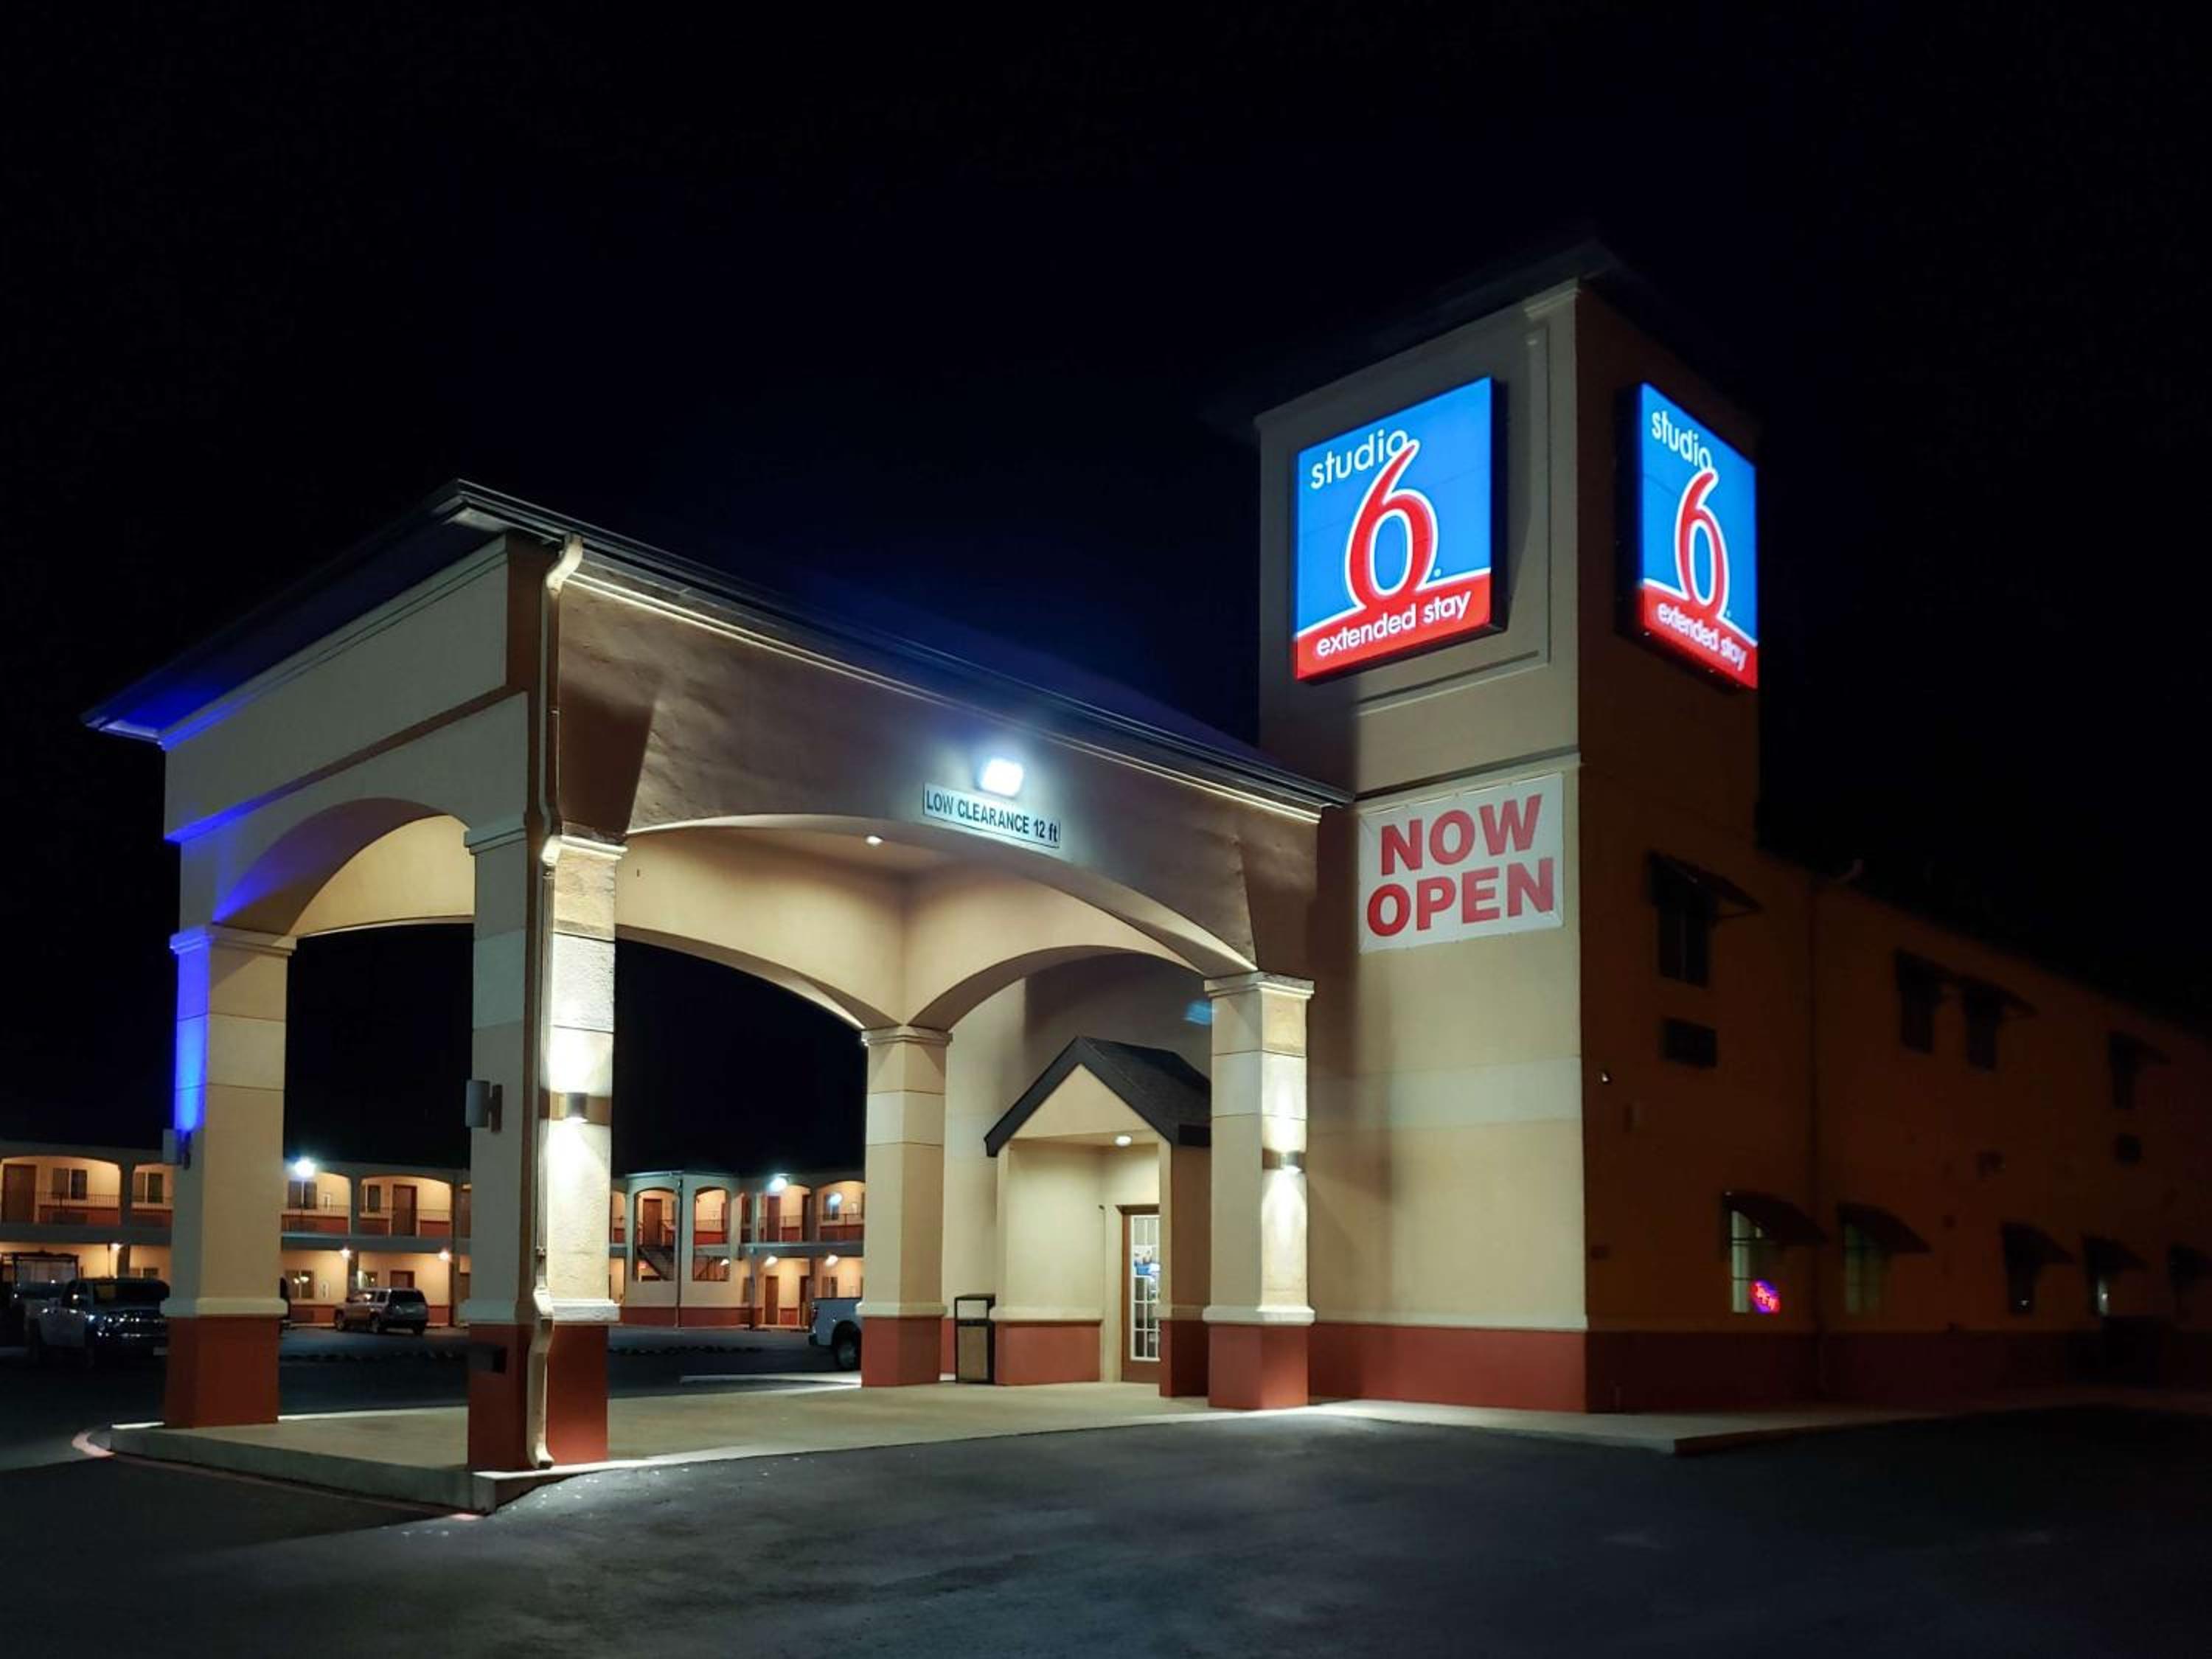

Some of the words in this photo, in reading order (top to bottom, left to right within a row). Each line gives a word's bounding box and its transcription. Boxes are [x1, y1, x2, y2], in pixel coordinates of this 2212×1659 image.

[1310, 428, 1408, 489] studio
[1652, 411, 1712, 471] studio
[1345, 439, 1439, 609] 6
[1674, 467, 1731, 618] 6
[1316, 603, 1416, 656] extended
[1423, 591, 1472, 625] stay
[1658, 602, 1719, 651] extended
[1720, 636, 1747, 672] stay
[927, 790, 953, 814] LOW
[958, 799, 1029, 834] CLEARANCE
[1034, 818, 1045, 838] 12
[1048, 823, 1058, 842] ft
[1381, 793, 1543, 876] NOW
[1367, 857, 1554, 937] OPEN
